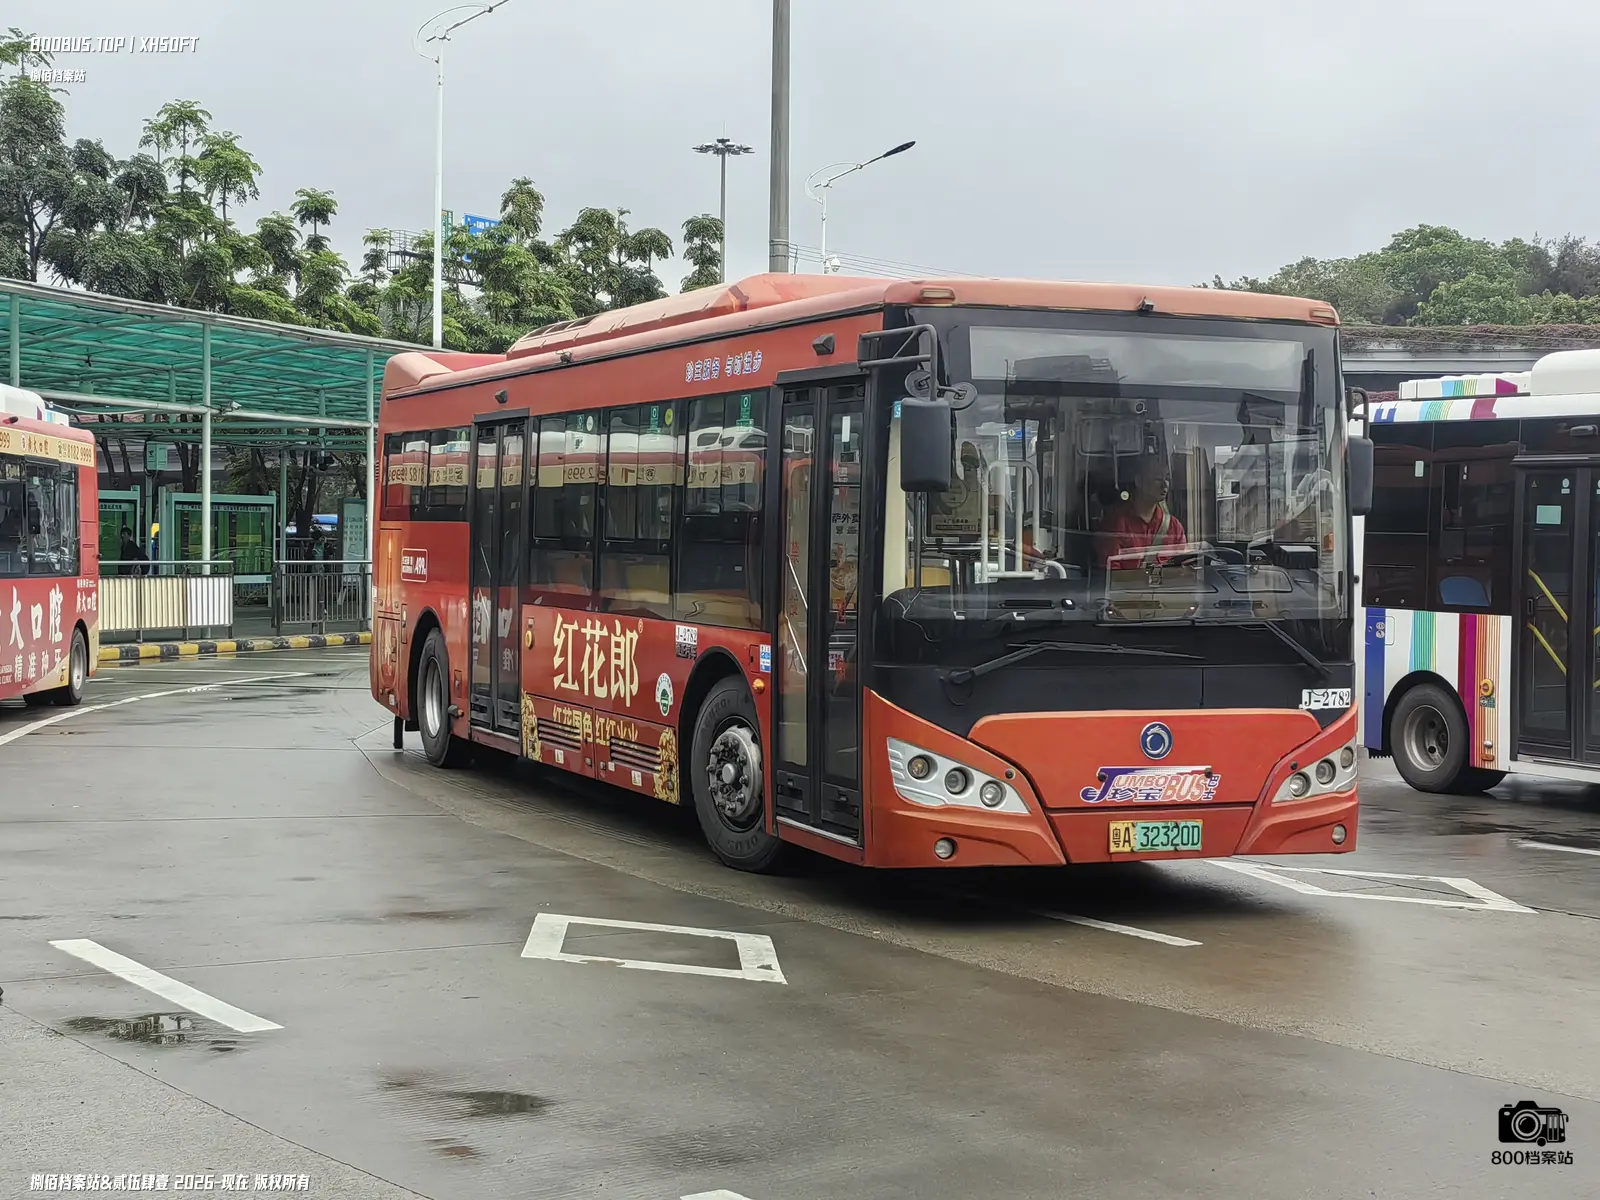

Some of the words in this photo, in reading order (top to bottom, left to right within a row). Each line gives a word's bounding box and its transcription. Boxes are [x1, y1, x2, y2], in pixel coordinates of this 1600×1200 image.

[0, 583, 63, 650] 大口腔
[677, 626, 697, 643] J-2782
[553, 612, 639, 708] 红花郎
[1304, 690, 1350, 707] J-2782
[1107, 787, 1162, 801] 珍宝
[1162, 774, 1206, 801] BUS
[1202, 775, 1219, 800] 巴士
